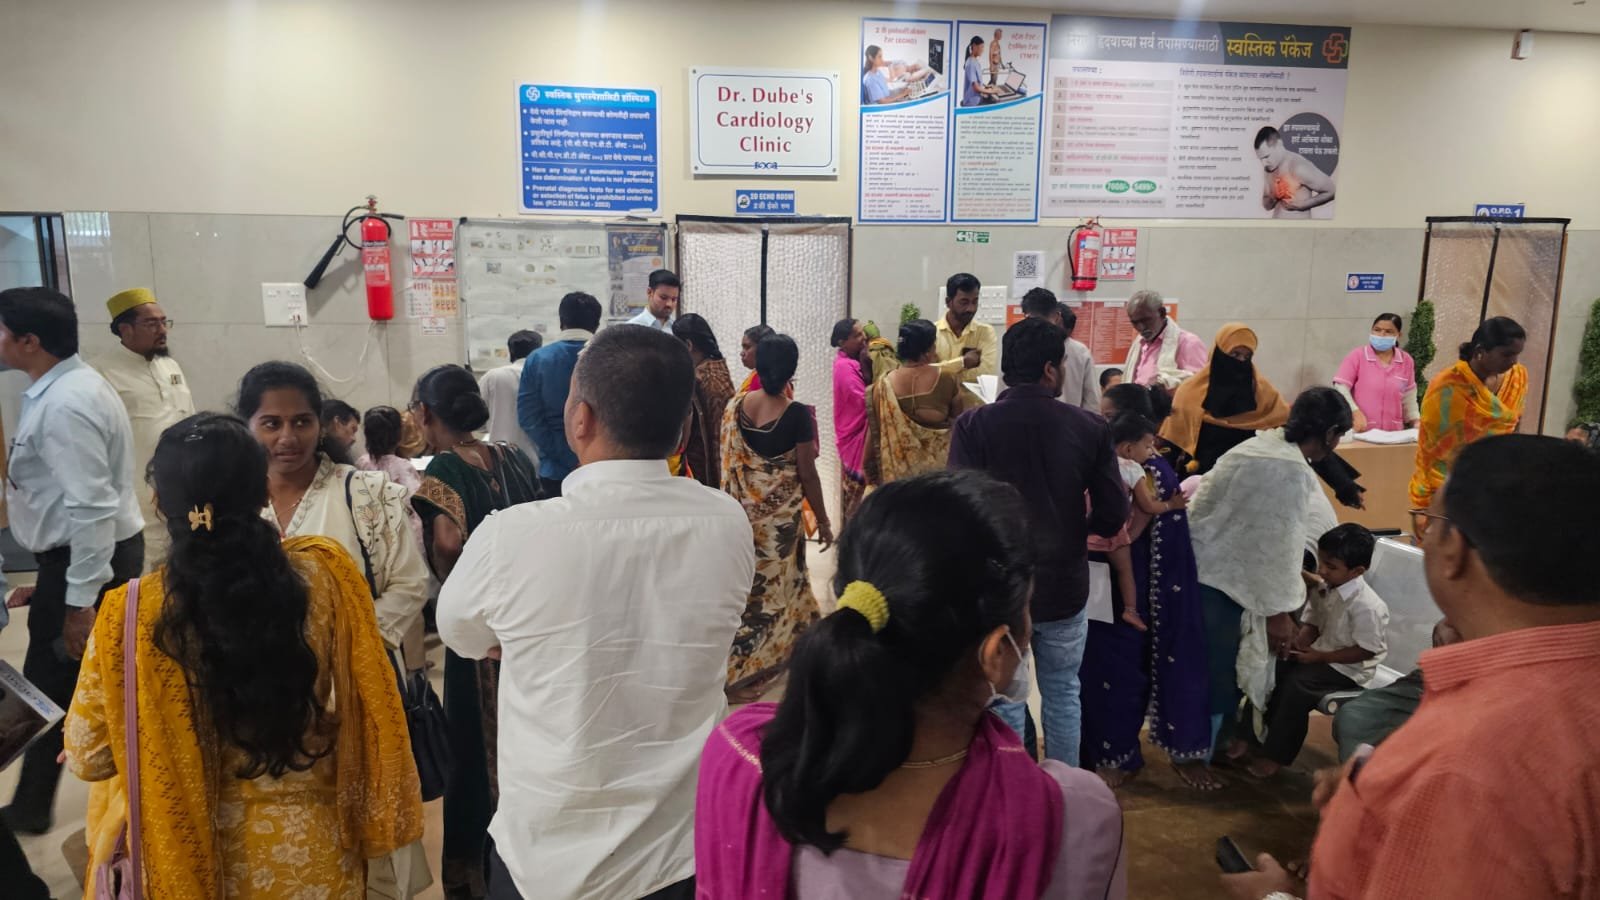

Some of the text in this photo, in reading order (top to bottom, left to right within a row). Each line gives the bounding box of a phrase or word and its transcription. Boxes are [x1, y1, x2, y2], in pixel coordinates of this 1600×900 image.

[1139, 31, 1156, 49] सर्व
[1226, 32, 1276, 58] स्वस्तिक
[1280, 33, 1313, 59] पॅकेज
[718, 86, 814, 105] Dr. Dube's
[717, 112, 814, 134] Cardiology
[740, 136, 792, 153] Clinic
[626, 169, 655, 177] regarding
[543, 174, 583, 182] determination
[623, 177, 655, 185] performed.
[558, 186, 588, 194] diagnostic
[597, 194, 625, 202] prohibited
[1491, 207, 1521, 217] O.P.D. 1
